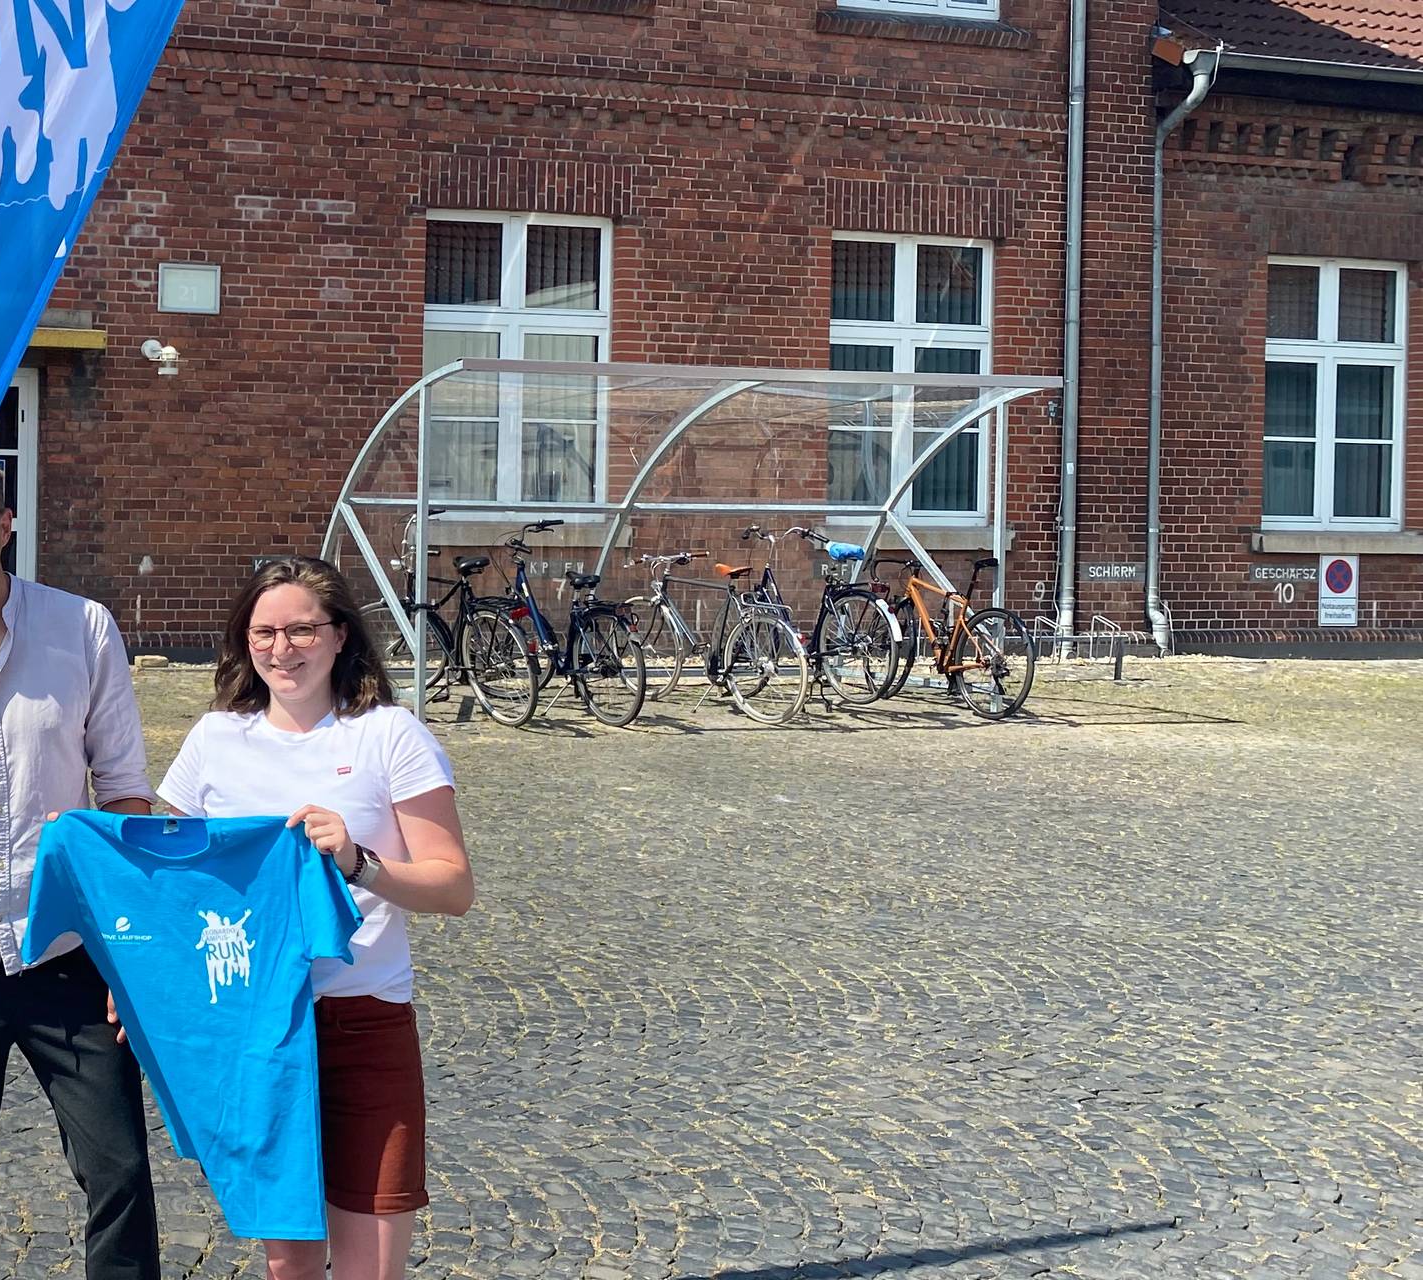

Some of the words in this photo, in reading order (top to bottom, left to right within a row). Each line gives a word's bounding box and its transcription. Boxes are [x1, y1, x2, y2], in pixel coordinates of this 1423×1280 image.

[178, 285, 197, 302] 21
[1088, 564, 1136, 578] SCHIRRM
[552, 577, 567, 601] 7
[1034, 581, 1046, 602] 9
[1274, 582, 1295, 604] 10
[207, 941, 245, 961] RUN
